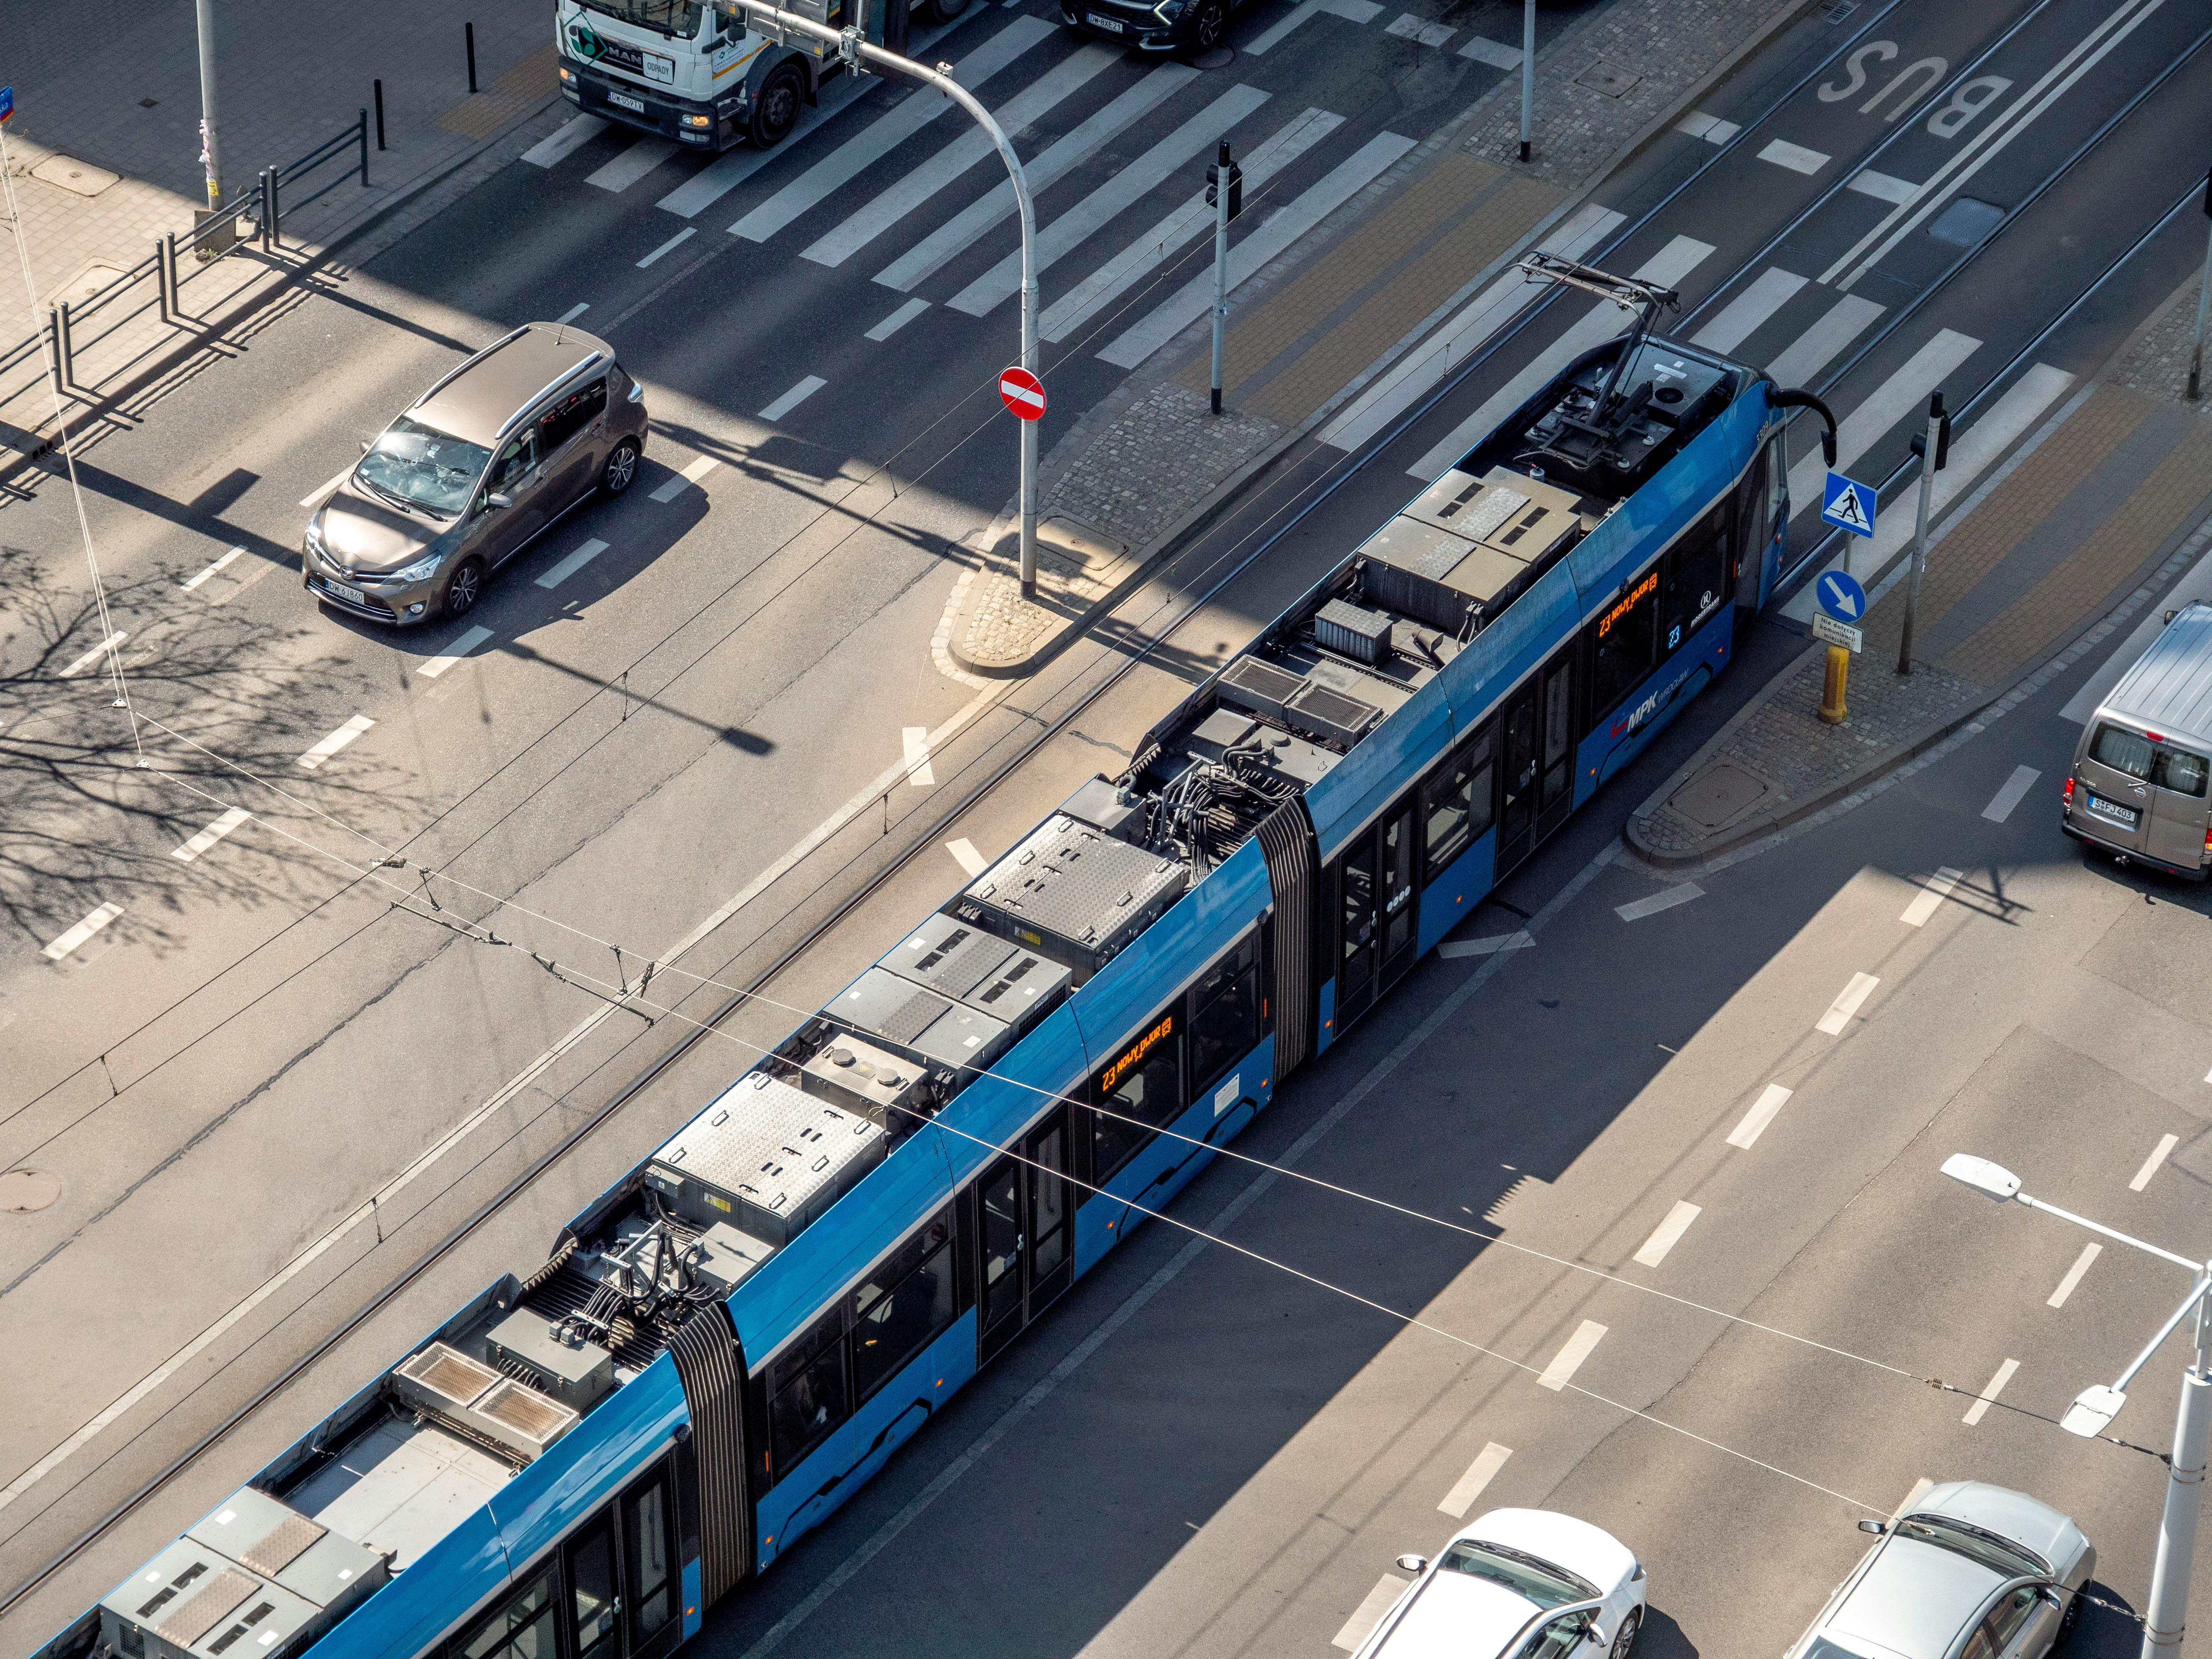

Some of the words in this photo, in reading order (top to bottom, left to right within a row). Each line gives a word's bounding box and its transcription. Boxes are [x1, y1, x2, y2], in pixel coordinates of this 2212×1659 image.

[1090, 15, 1098, 23] DW
[1101, 19, 1120, 30] 8XE21
[609, 47, 641, 64] MAN
[647, 62, 669, 76] ODPADY
[1818, 40, 2014, 139] BUS
[612, 93, 620, 102] DW
[622, 97, 642, 109] 059TV
[1756, 420, 1769, 445] 3309
[329, 582, 339, 592] DW
[341, 588, 363, 601] 6J860
[1600, 614, 1611, 638] 23
[1612, 597, 1630, 621] NOWY
[1691, 596, 1720, 627] MODERTRANS
[1820, 625, 1855, 642] komunikacji
[1833, 623, 1856, 636] dotyczy
[1824, 634, 1850, 647] miejskiej
[1627, 690, 1658, 733] MPK
[2105, 803, 2116, 813] FJ
[2117, 809, 2132, 819] 403
[1103, 1066, 1115, 1091] 23
[1117, 1045, 1138, 1073] NOWY
